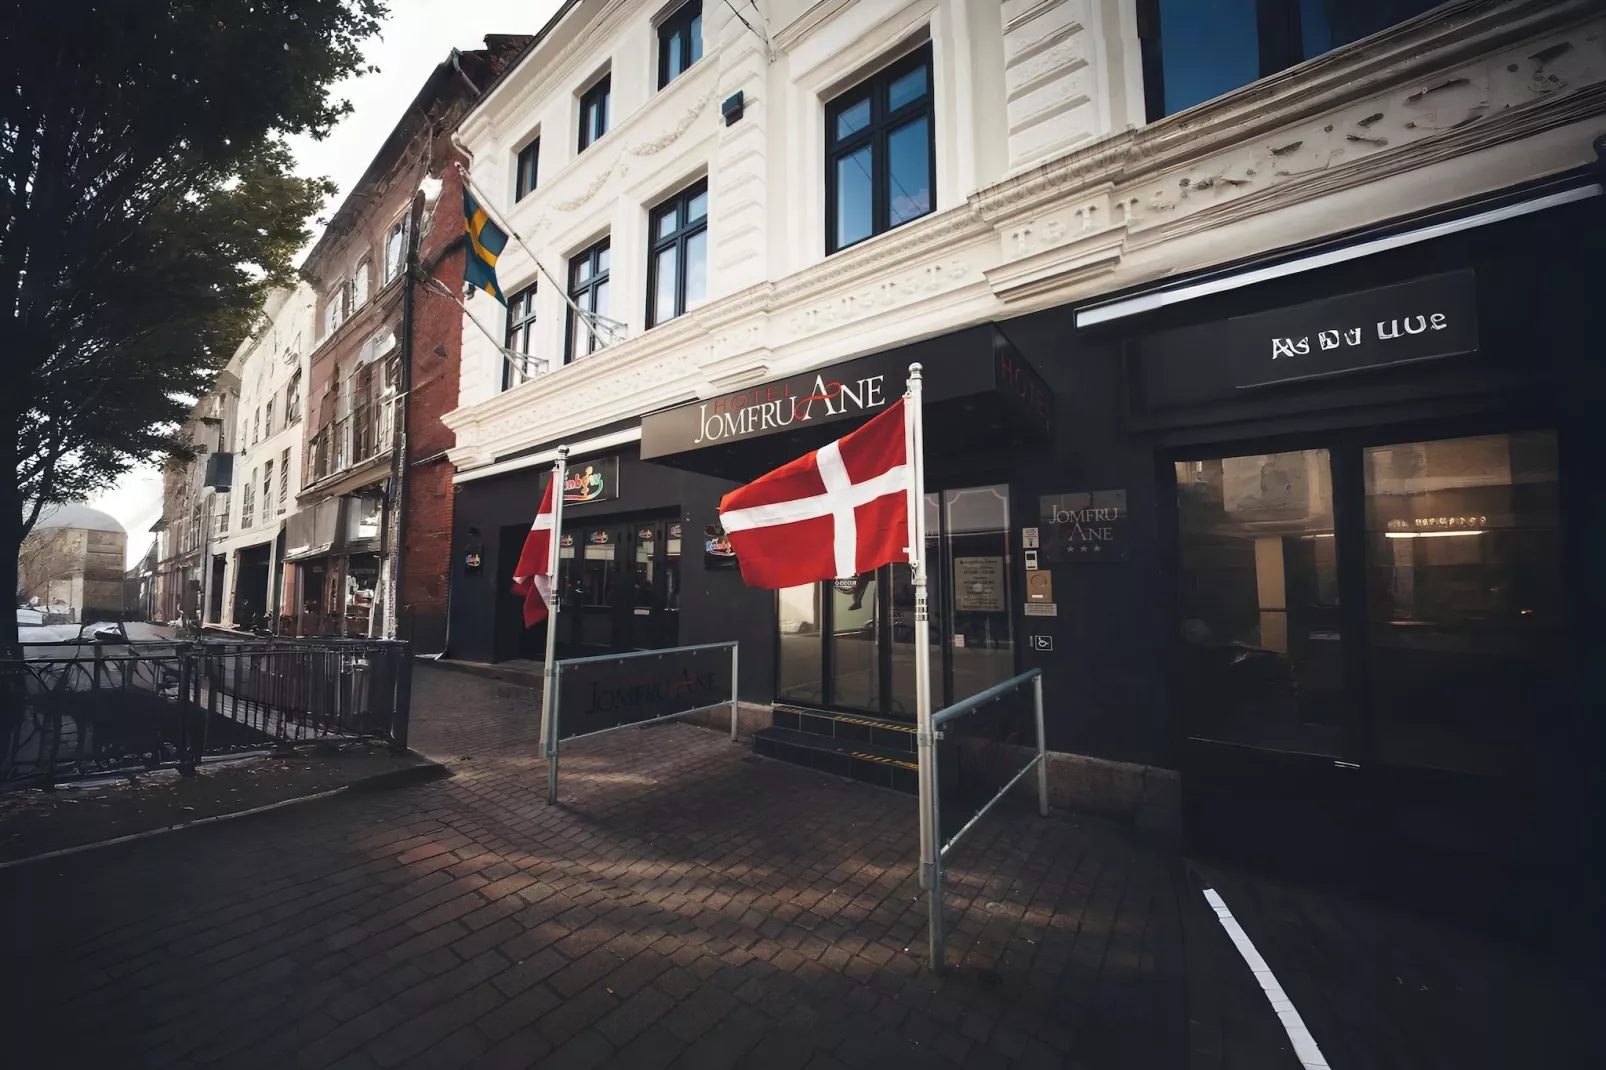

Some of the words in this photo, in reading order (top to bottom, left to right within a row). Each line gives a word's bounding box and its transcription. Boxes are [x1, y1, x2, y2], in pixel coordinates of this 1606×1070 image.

[694, 395, 798, 444] JOMFRU
[801, 375, 886, 421] ANE
[713, 382, 796, 413] HOTEL
[1049, 504, 1119, 524] JOMFRU
[1068, 523, 1114, 541] ANE
